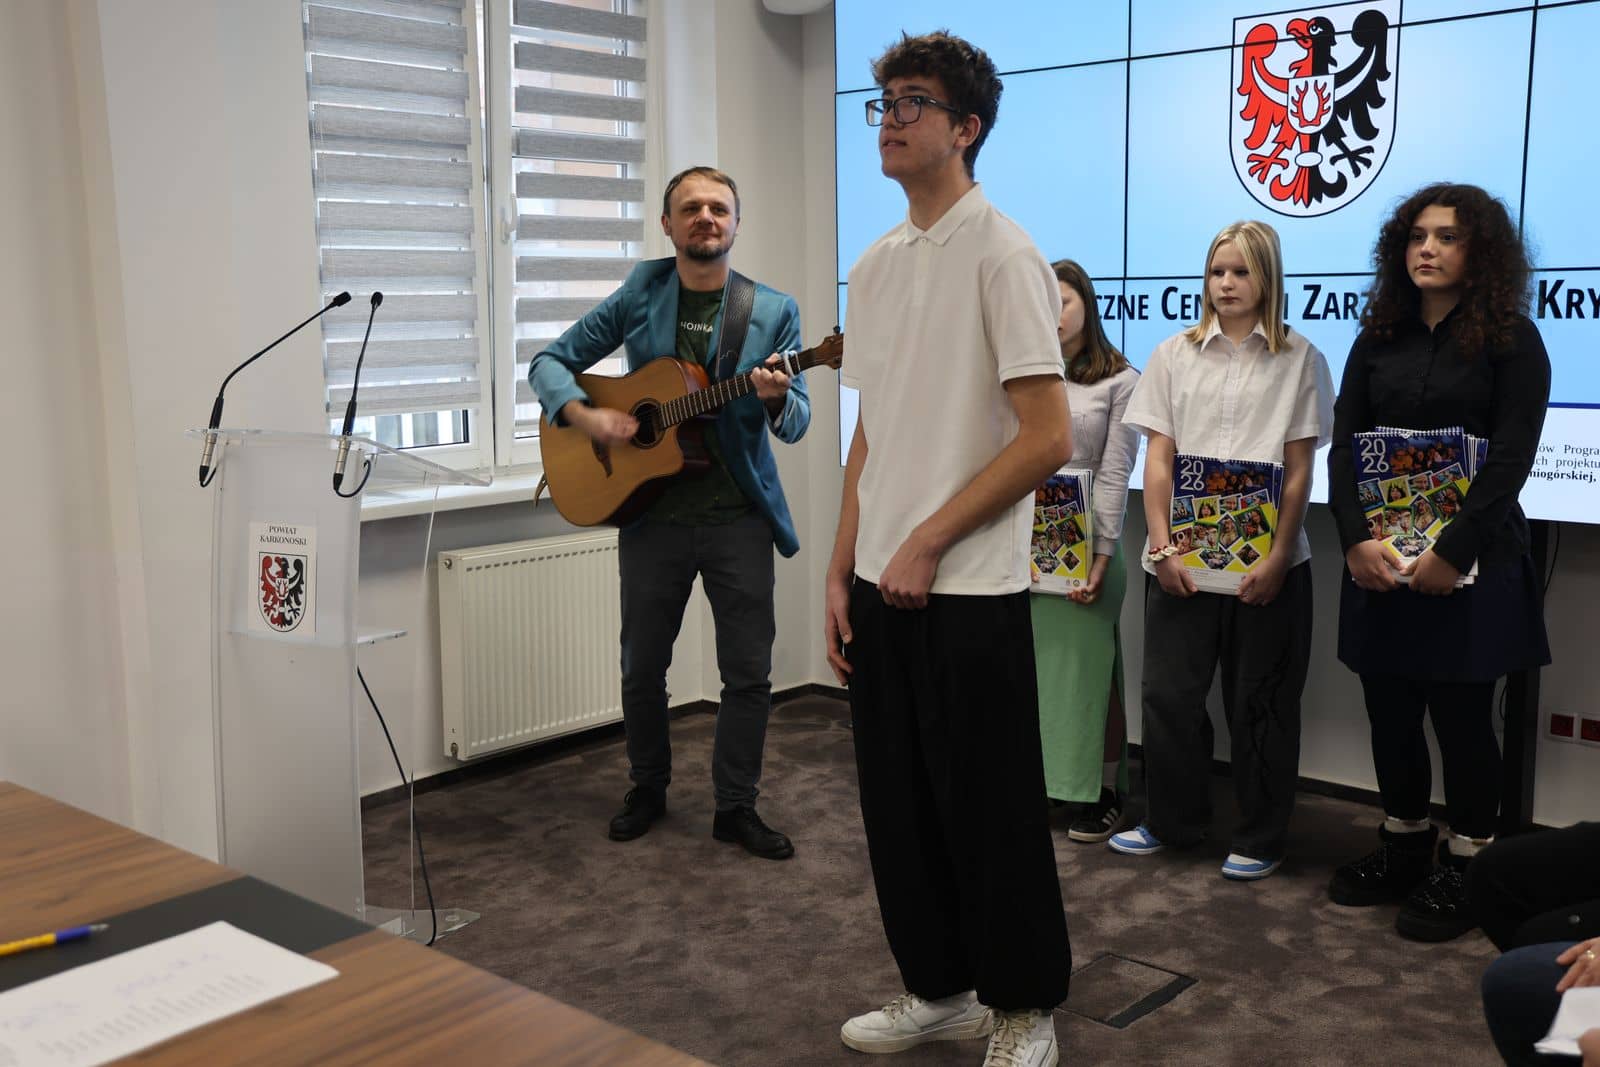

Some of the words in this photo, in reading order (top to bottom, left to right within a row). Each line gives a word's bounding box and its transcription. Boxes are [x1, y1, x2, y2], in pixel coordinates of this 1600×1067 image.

[1096, 294, 1149, 320] ZNE
[1360, 438, 1386, 456] 20
[1180, 458, 1204, 475] 20
[1362, 455, 1389, 473] 26
[1180, 473, 1205, 491] 26
[269, 525, 297, 535] POWIAT
[260, 535, 307, 545] KARKONOSKI
